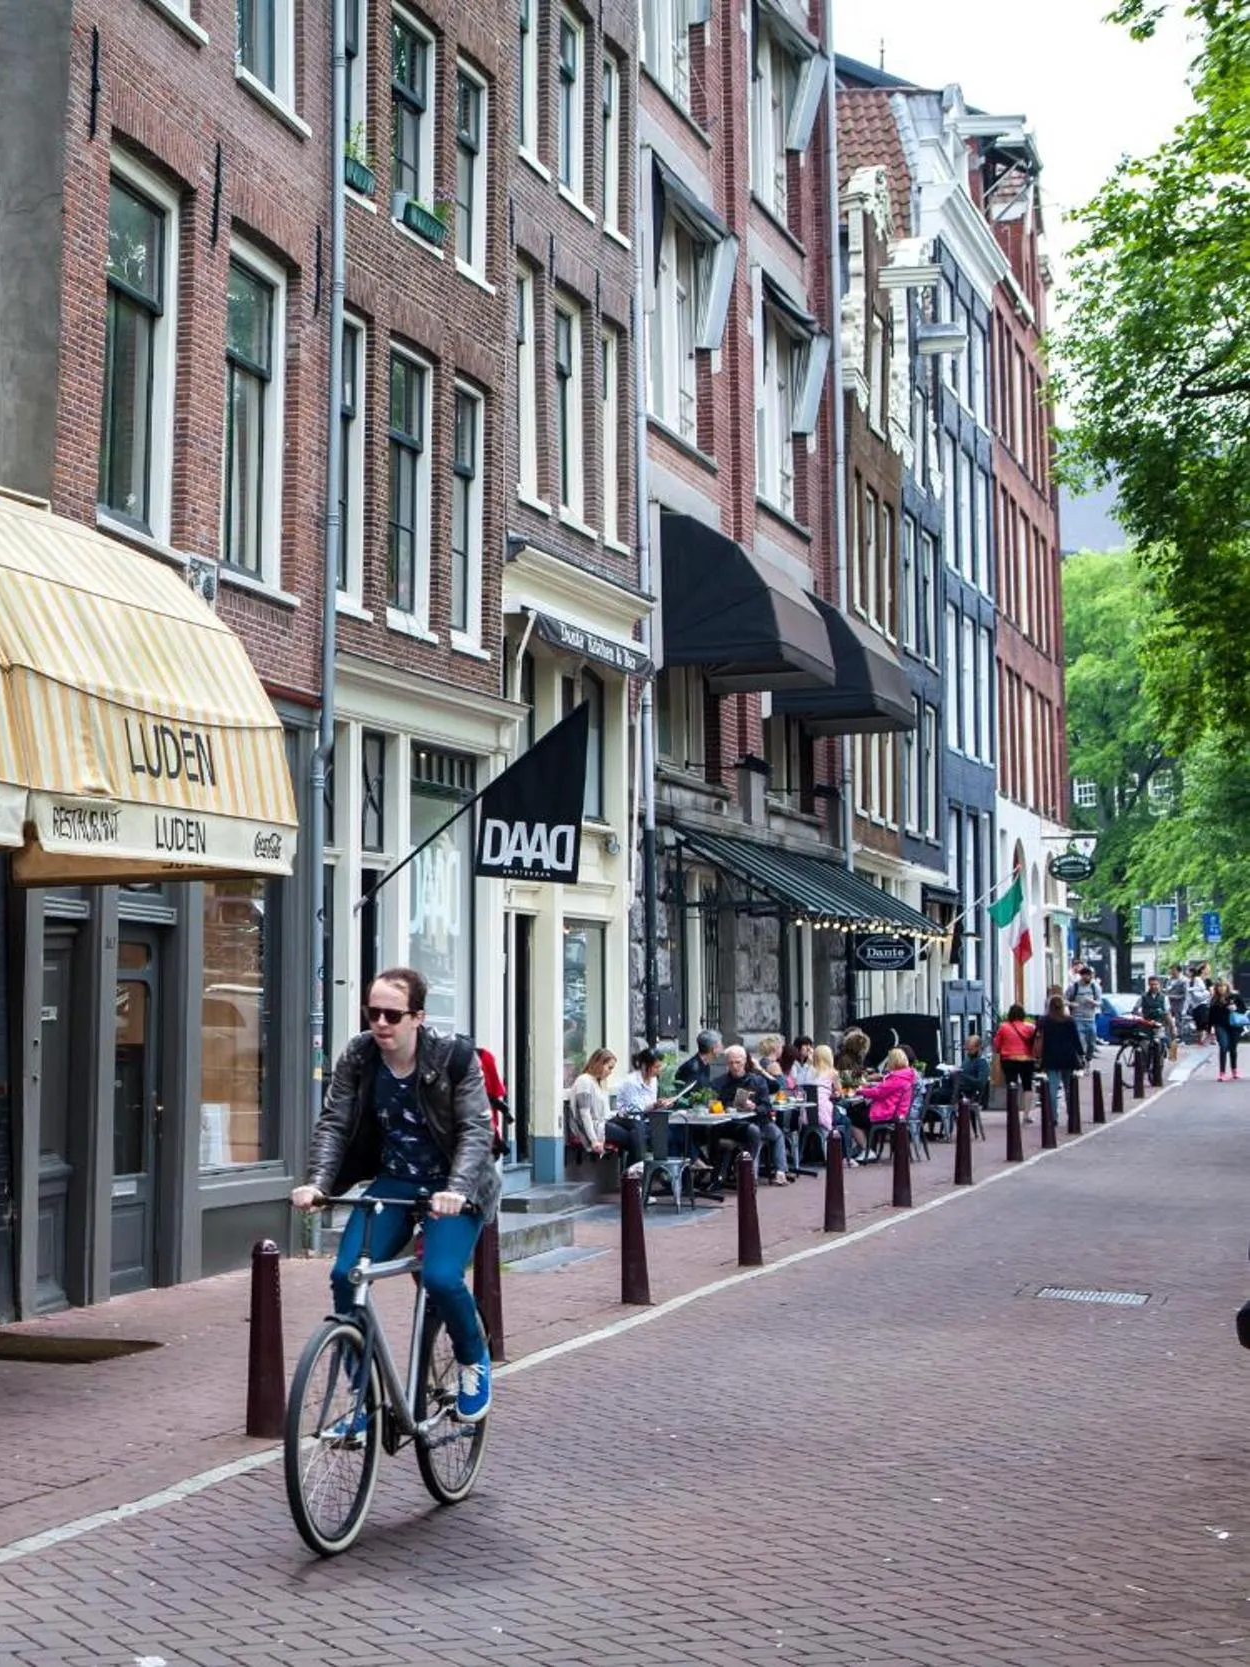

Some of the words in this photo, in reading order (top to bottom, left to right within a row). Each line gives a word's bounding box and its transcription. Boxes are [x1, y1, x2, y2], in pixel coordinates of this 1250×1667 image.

[124, 717, 217, 787] LUDEN
[52, 806, 123, 842] RESTAURANT
[154, 814, 206, 854] LUDEN
[481, 818, 576, 871] DAAD
[502, 868, 551, 878] AMSTERDAM
[865, 947, 905, 959] Dante
